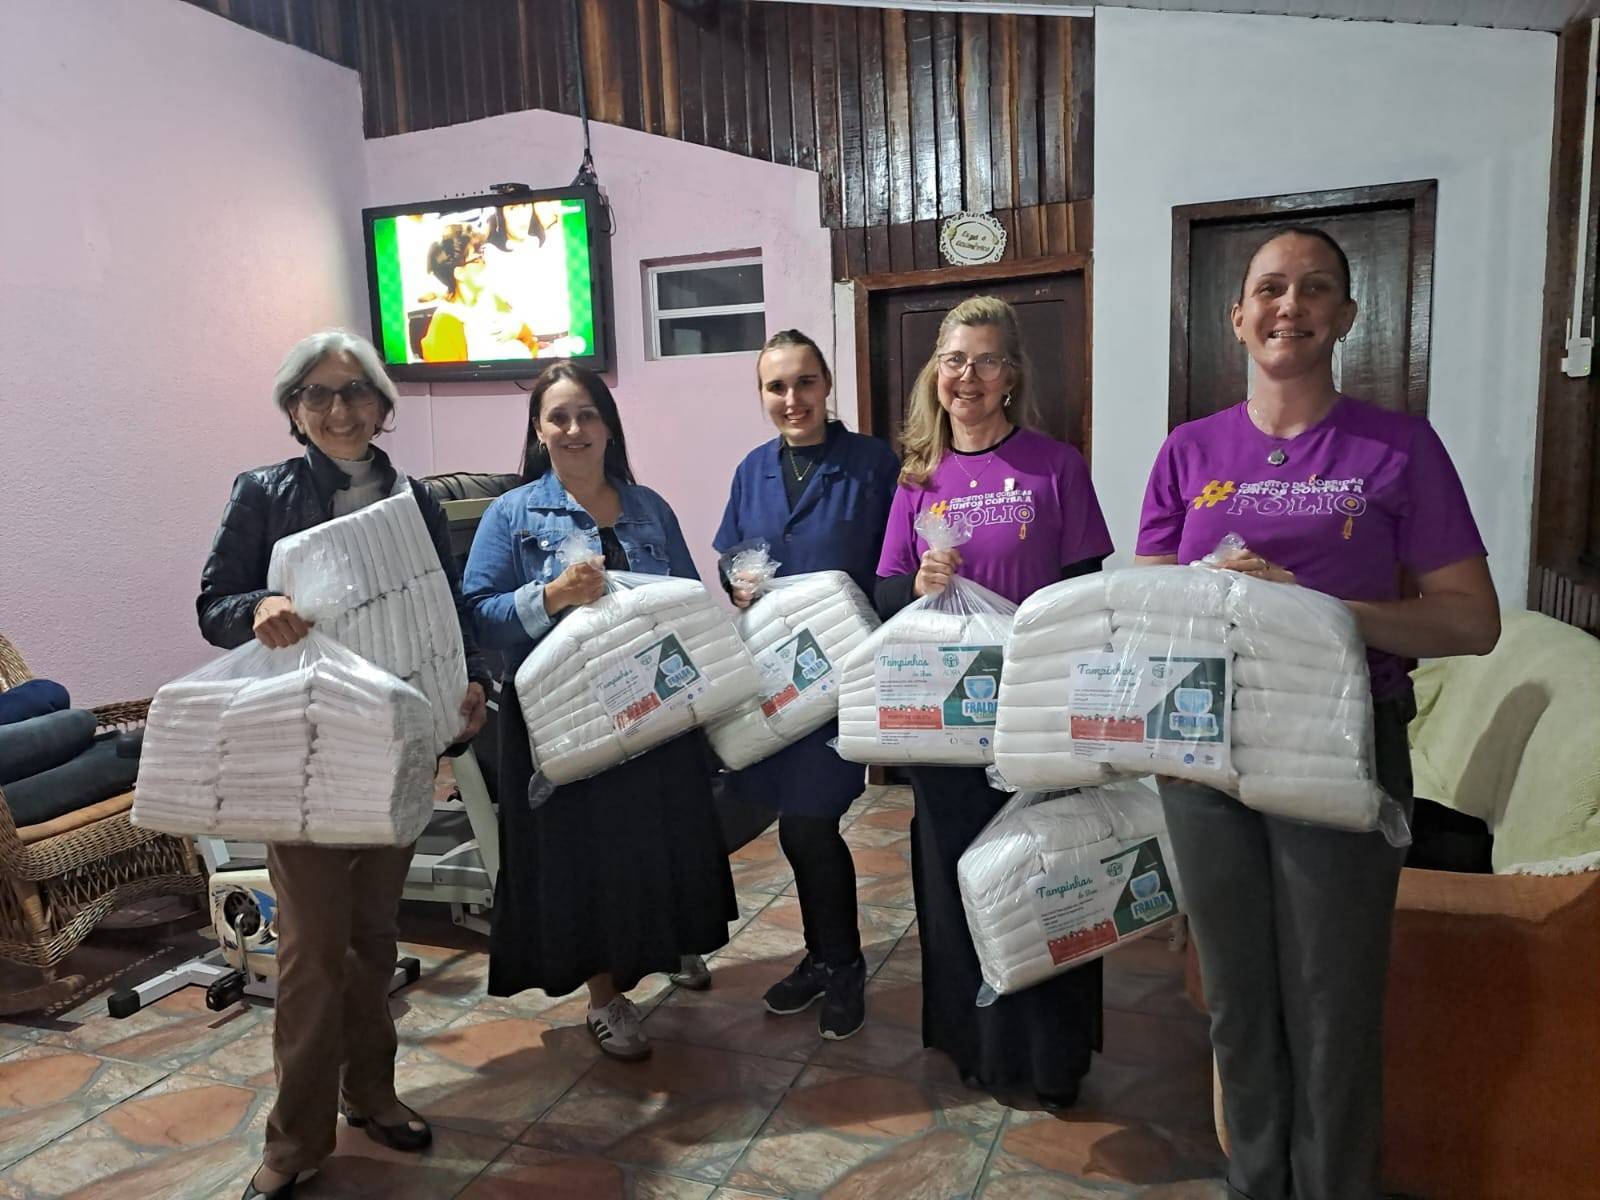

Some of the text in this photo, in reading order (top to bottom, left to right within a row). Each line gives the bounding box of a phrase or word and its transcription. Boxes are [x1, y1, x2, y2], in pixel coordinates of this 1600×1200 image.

[1291, 484, 1350, 495] CONTRA
[949, 501, 983, 511] JUNTOS
[985, 497, 1021, 506] CONTRA
[1227, 493, 1367, 516] POLIO
[947, 504, 1035, 528] POLIO
[880, 653, 929, 671] Tampinhas
[1036, 874, 1093, 899] Tampinhas
